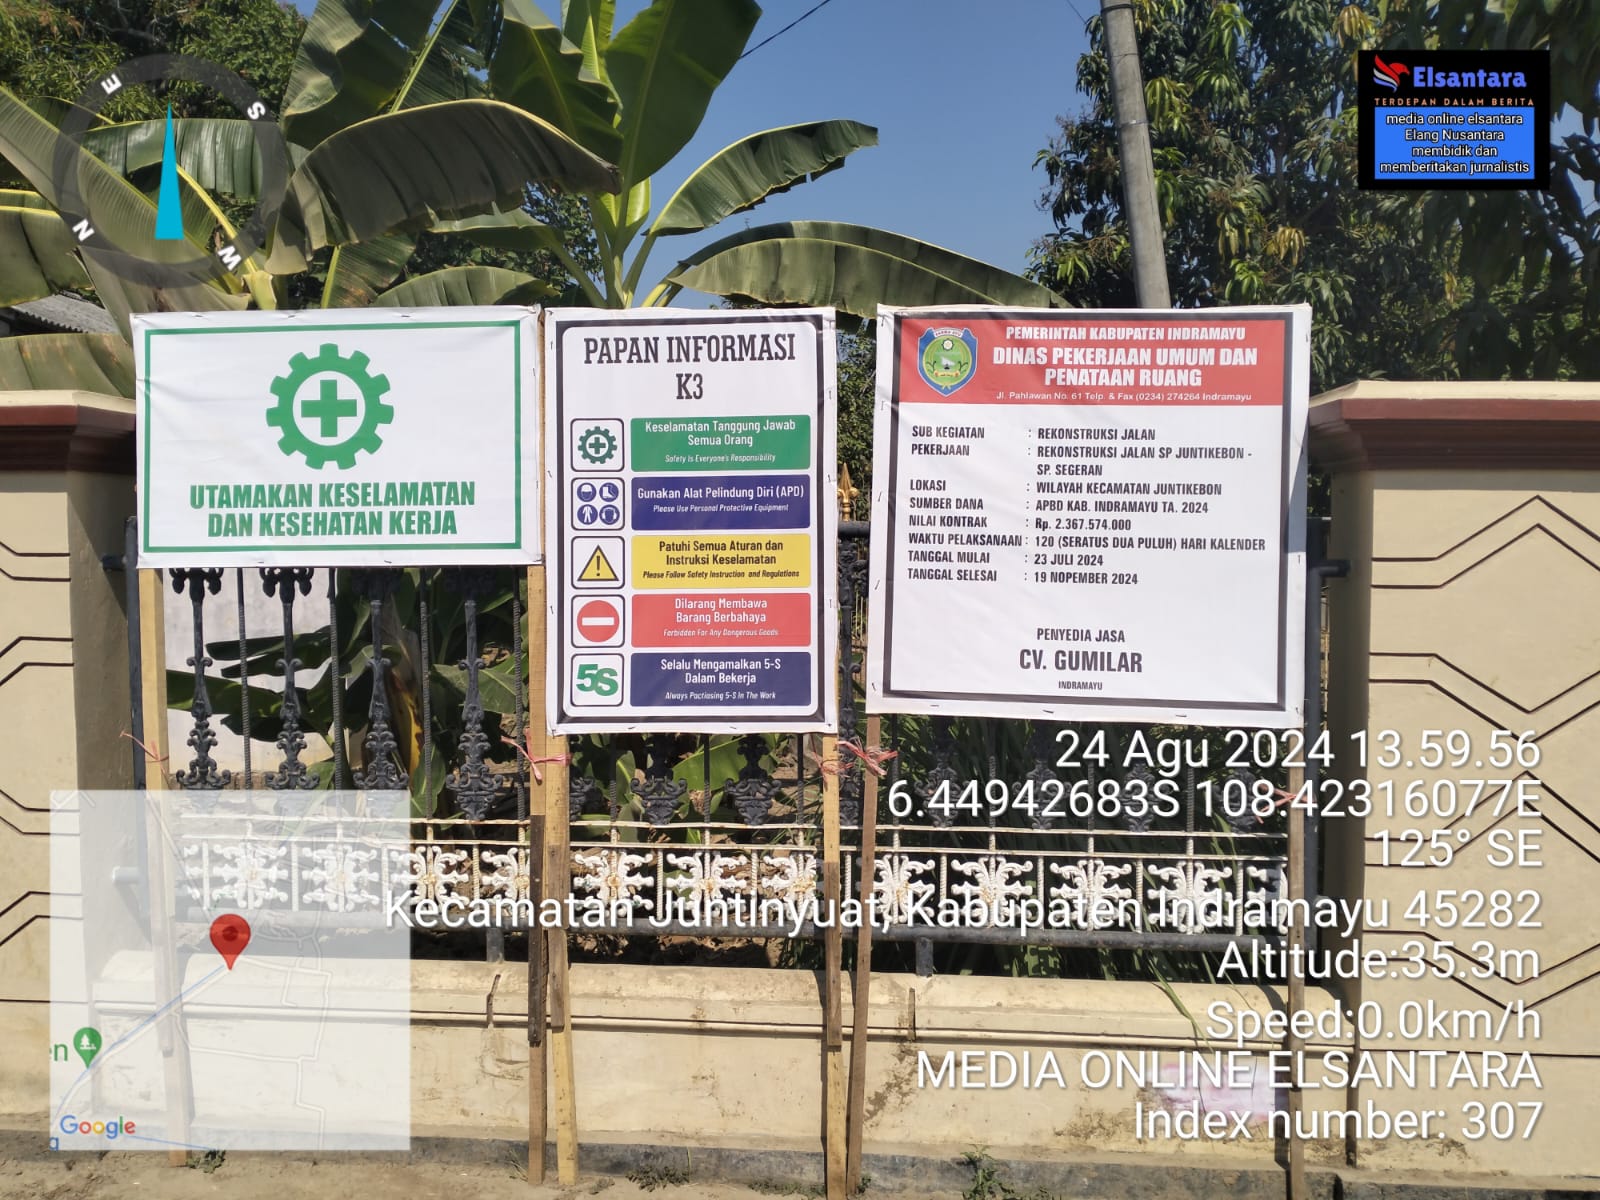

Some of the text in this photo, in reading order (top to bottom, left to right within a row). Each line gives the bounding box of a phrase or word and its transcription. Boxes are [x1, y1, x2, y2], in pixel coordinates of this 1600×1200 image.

[1006, 326, 1245, 340] PEMERINTAH KABUPATEN INDRAMAYU
[584, 333, 796, 364] PAPAN INFORMASI
[993, 347, 1257, 366] DINAS PEKERJAAN UMUM DAN
[1045, 368, 1202, 386] PENATAAN RUANG
[676, 373, 703, 400] K3
[1009, 392, 1051, 400] Pahlawan
[1136, 393, 1164, 401] (0234)
[1203, 393, 1251, 402] Indramayu
[645, 420, 795, 433] Keselamatan Tanggung Jawab
[912, 426, 1155, 440] SUB KEGIATAN REKONSTRUKSI JALAN
[688, 434, 753, 447] Semua Orang
[731, 453, 776, 463] Responsibility
[912, 444, 1244, 459] PEKERJAAN REKONSTRUKSI JALAN SP JUNTIKEBON
[1037, 464, 1102, 476] SP. SEGERAN
[638, 485, 804, 500] Gunakan Alat Pelindung Diri (APD)
[910, 480, 1222, 495] LOKASI WILAYAH KECAMATAN JUNTIKEBON
[190, 482, 475, 509] UTAMAKAN KESELAMATAN
[690, 504, 718, 512] Personal
[720, 504, 752, 512] Protective
[754, 503, 788, 512] Equipment
[910, 498, 1208, 513] SUMBER DANA APBD KAB. INDRAMAYU TA. 2024
[208, 510, 457, 537] DAN KESEHATAN KERJA
[909, 515, 1131, 531] NILAI KONTRAK Rp. 2.367.574.000
[659, 540, 783, 551] Patuhi Semua Aturan dan
[909, 533, 1265, 551] WAKTU PELAKSANAAN 120 (SERATUS DUA PULUH) HARI KALENDER
[666, 554, 776, 565] Instruksi Keselamatan
[908, 551, 1103, 566] TANGGAL MULAI 23 JULI 2024
[688, 571, 708, 579] Safety
[710, 570, 745, 578] Instruction
[762, 570, 799, 579] Regulations
[908, 568, 1138, 584] TANGGAL SELESAI 19 NOPEMBER 2024
[675, 598, 767, 610] Dilarang Membawa
[676, 612, 766, 624] Barang Berbahaya
[710, 629, 721, 637] Any
[1037, 628, 1125, 642] PENYEDIA JASA
[661, 659, 781, 672] Selalu Mengamalkan 5-S
[1020, 649, 1142, 673] CV. GUMILAR
[576, 664, 619, 696] 5S
[685, 672, 756, 686] Dalam Bekerja
[1059, 680, 1103, 690] INDRAMAYU
[665, 692, 688, 701] Always
